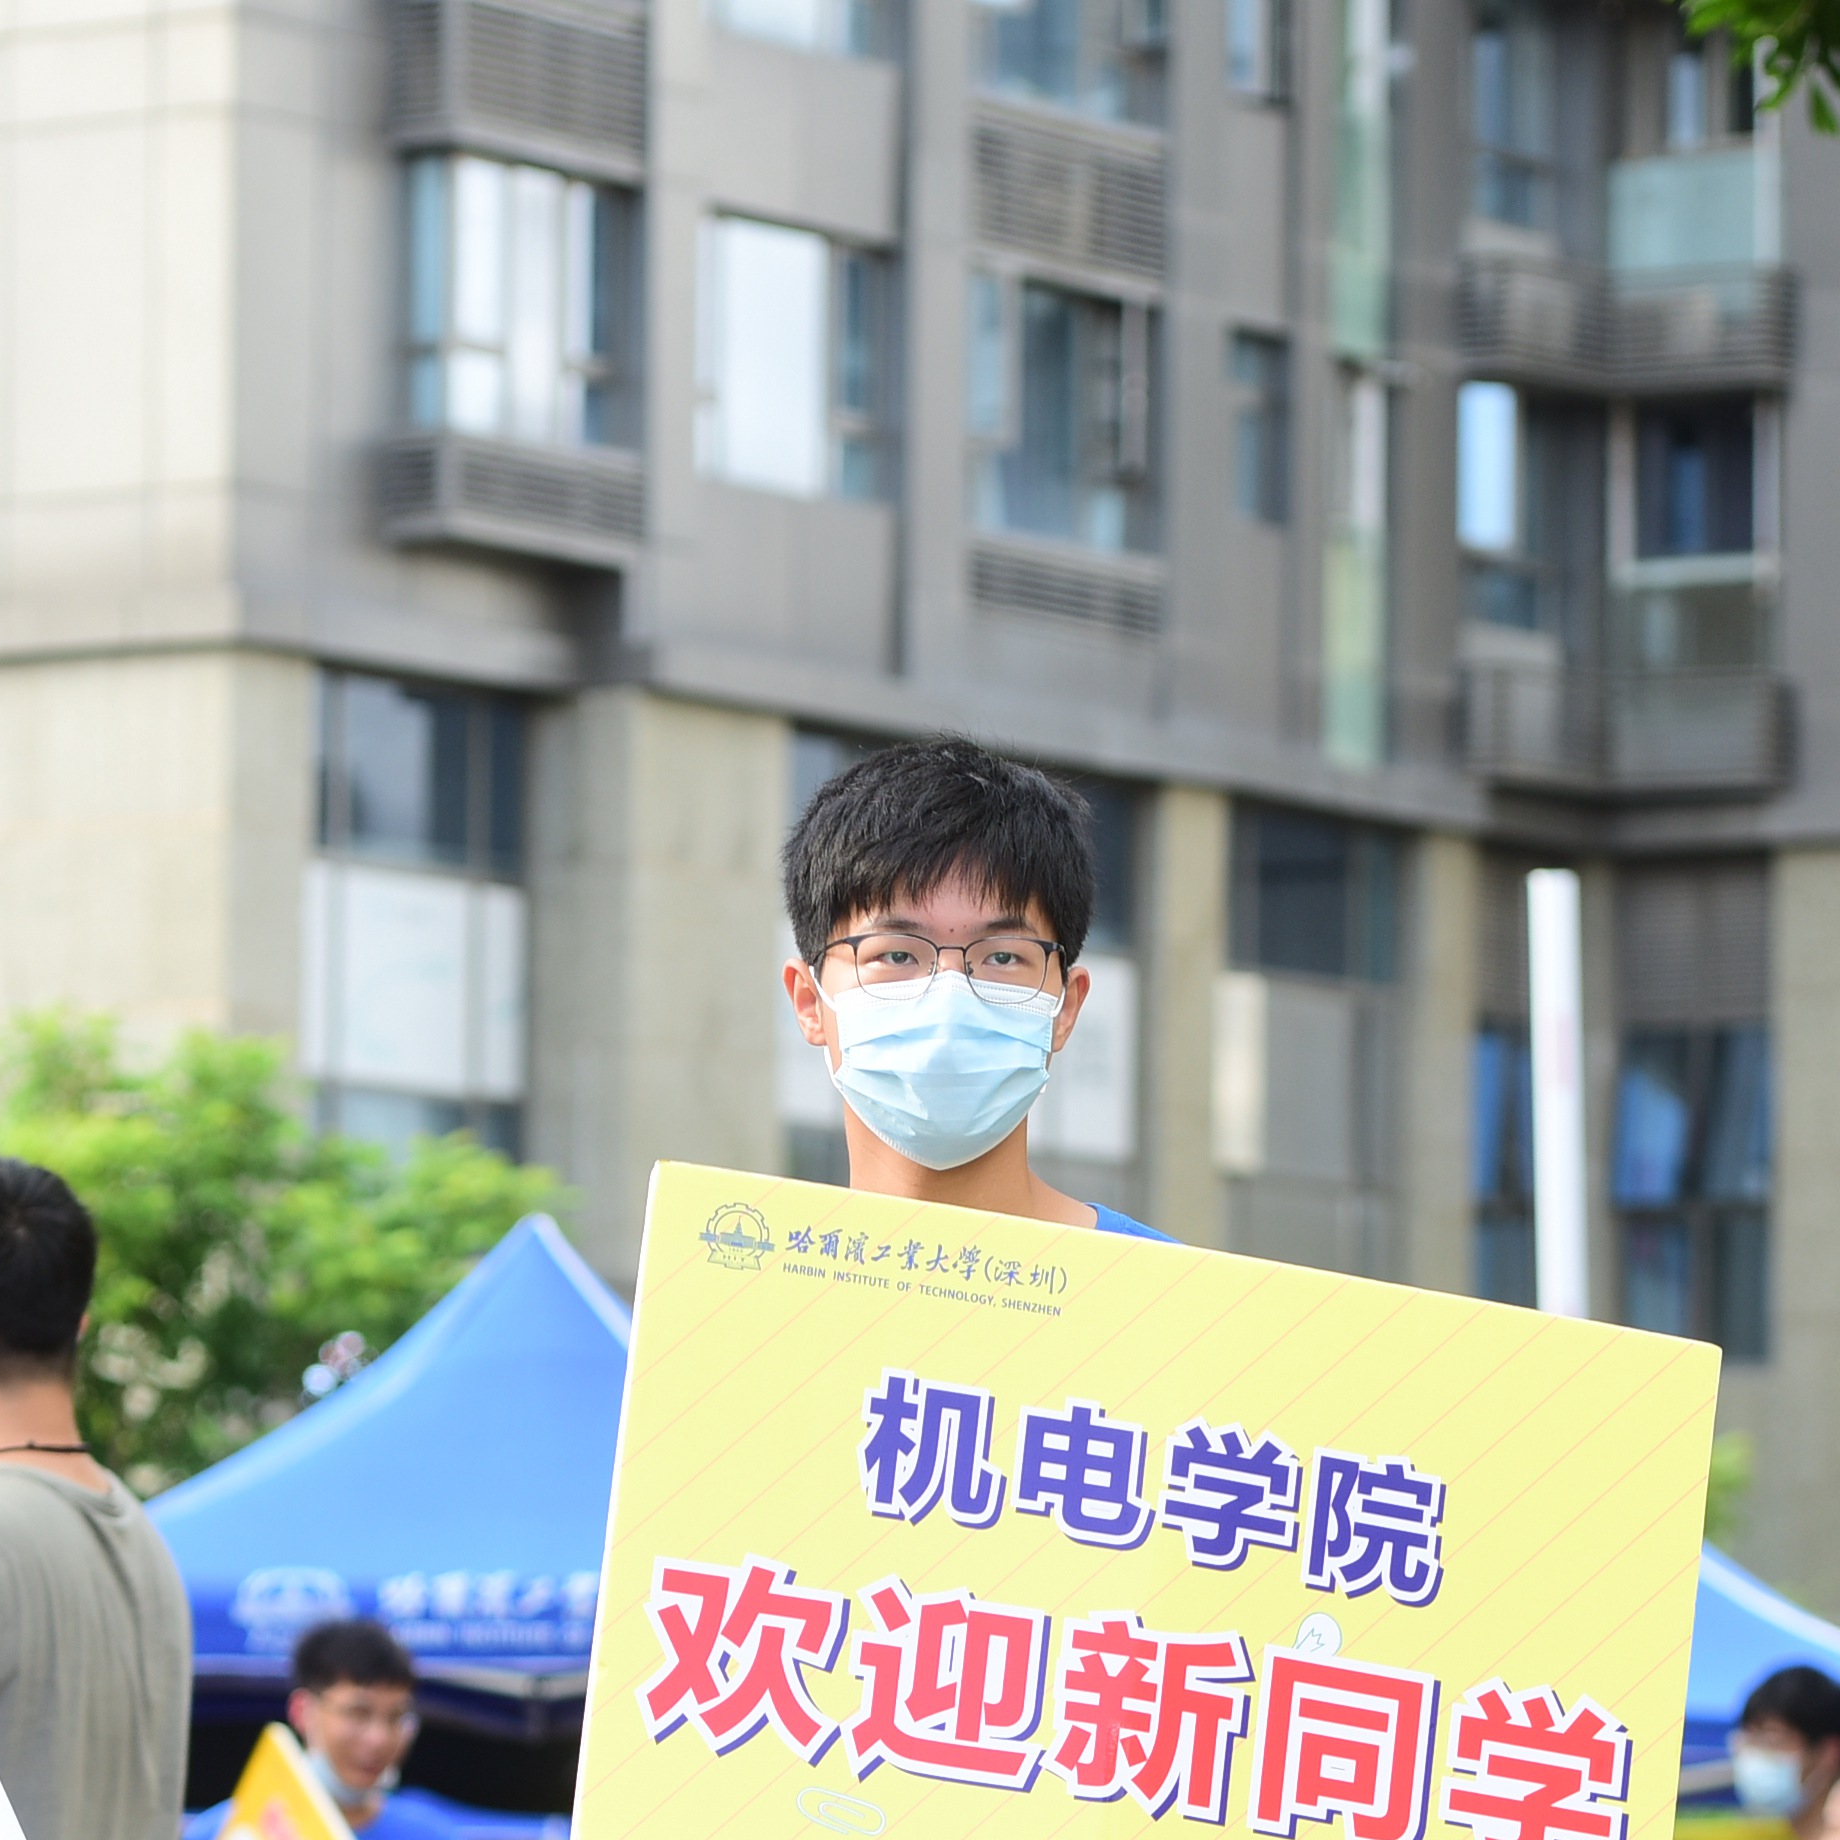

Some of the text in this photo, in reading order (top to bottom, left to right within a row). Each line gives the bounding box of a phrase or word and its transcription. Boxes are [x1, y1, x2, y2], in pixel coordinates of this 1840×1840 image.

[783, 1262, 1062, 1317] HARBIN INSTITUTE OF TECHNOLOGY, SHENZHEN
[858, 1368, 1445, 1607] 机电学院
